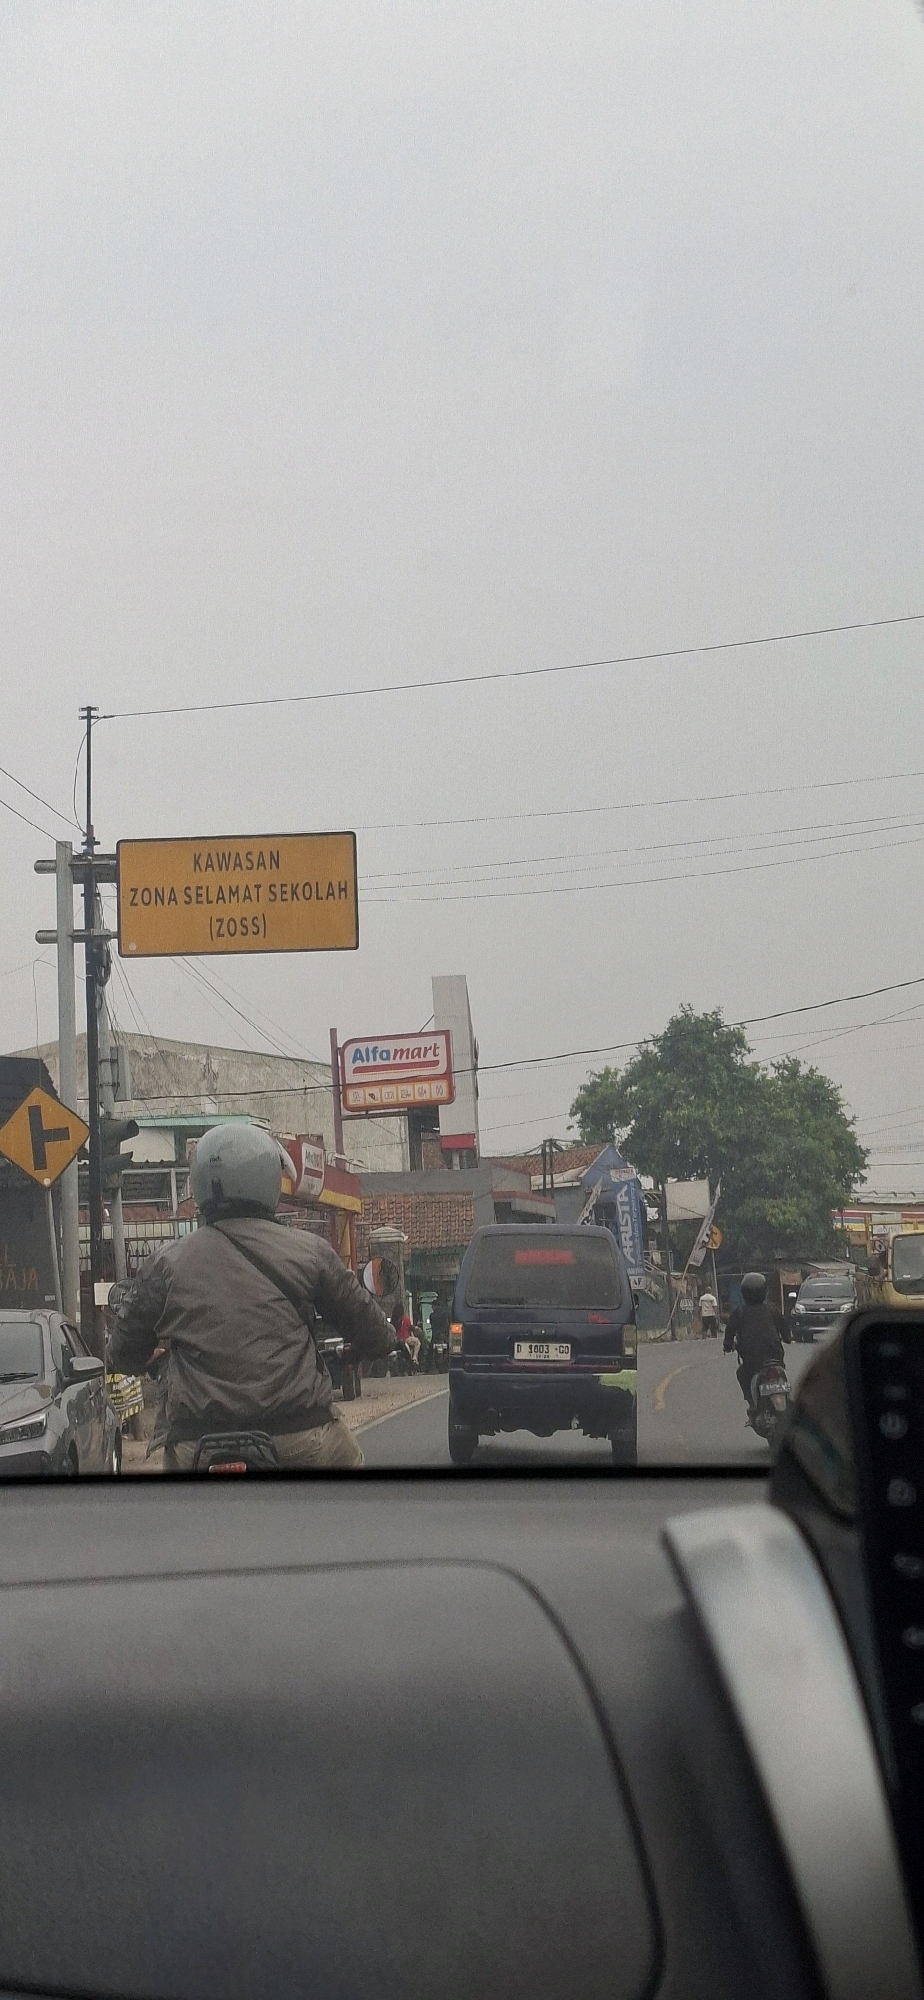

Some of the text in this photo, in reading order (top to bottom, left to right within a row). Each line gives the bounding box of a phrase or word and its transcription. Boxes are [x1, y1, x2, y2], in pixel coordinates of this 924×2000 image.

[193, 850, 280, 872] KAWASAN
[129, 880, 348, 907] ZONA SELAMAT SEKOLAH
[209, 913, 267, 941] (ZOSS)
[351, 1042, 440, 1065] Alfamart
[616, 1184, 635, 1265] ARISTA
[0, 1268, 39, 1290] AJA
